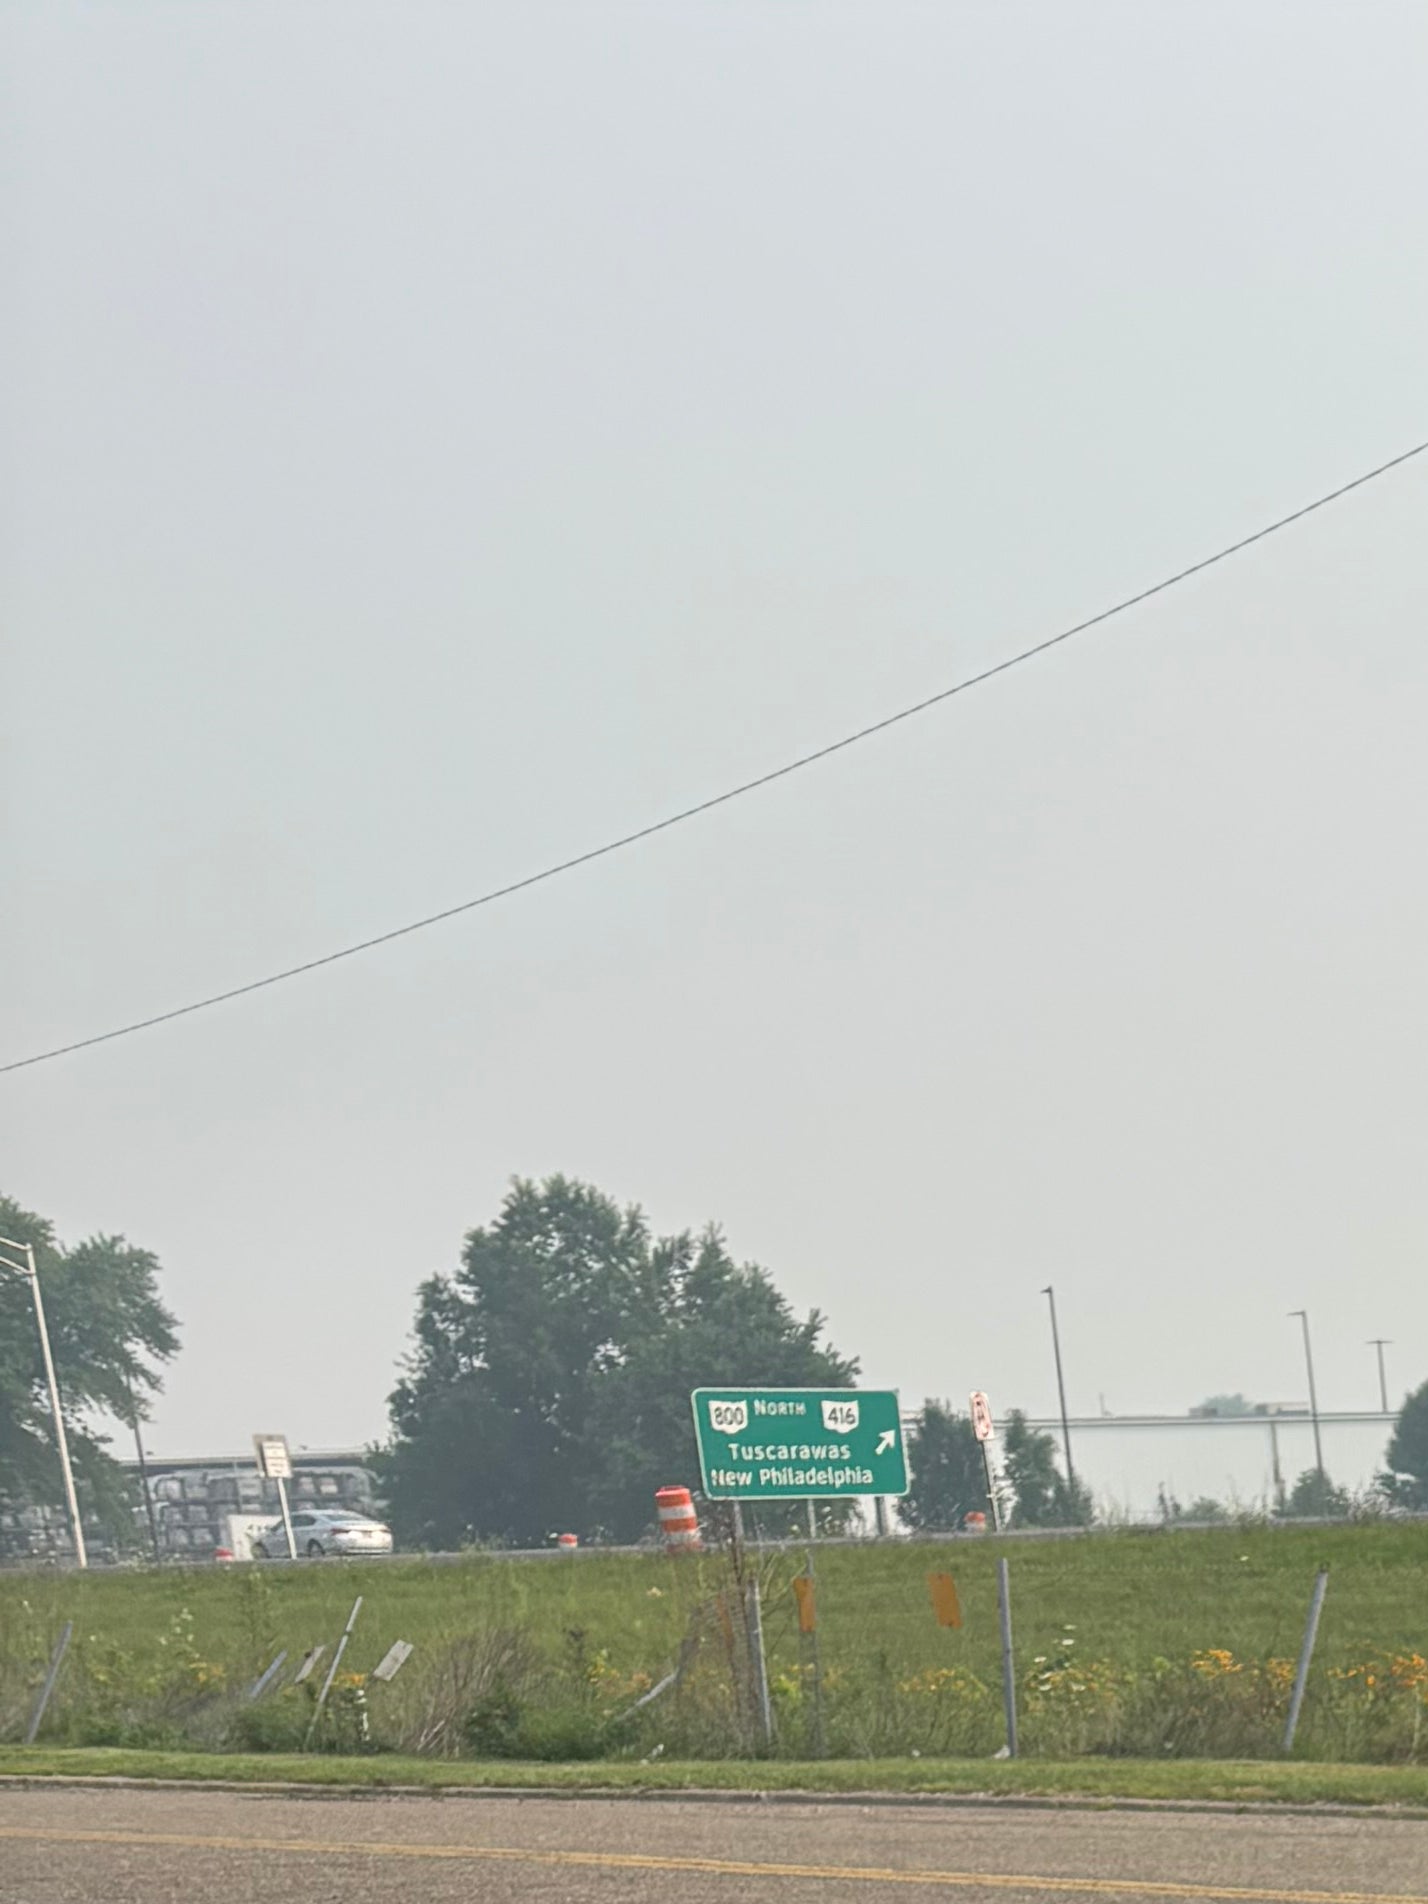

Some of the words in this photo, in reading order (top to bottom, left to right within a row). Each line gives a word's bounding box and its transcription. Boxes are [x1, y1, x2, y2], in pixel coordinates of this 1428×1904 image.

[713, 1406, 745, 1426] 800
[753, 1399, 806, 1416] NORTH
[827, 1407, 856, 1426] 416
[727, 1442, 851, 1461] Tuscarawas
[710, 1468, 753, 1486] New
[759, 1466, 874, 1488] Philadelphia
